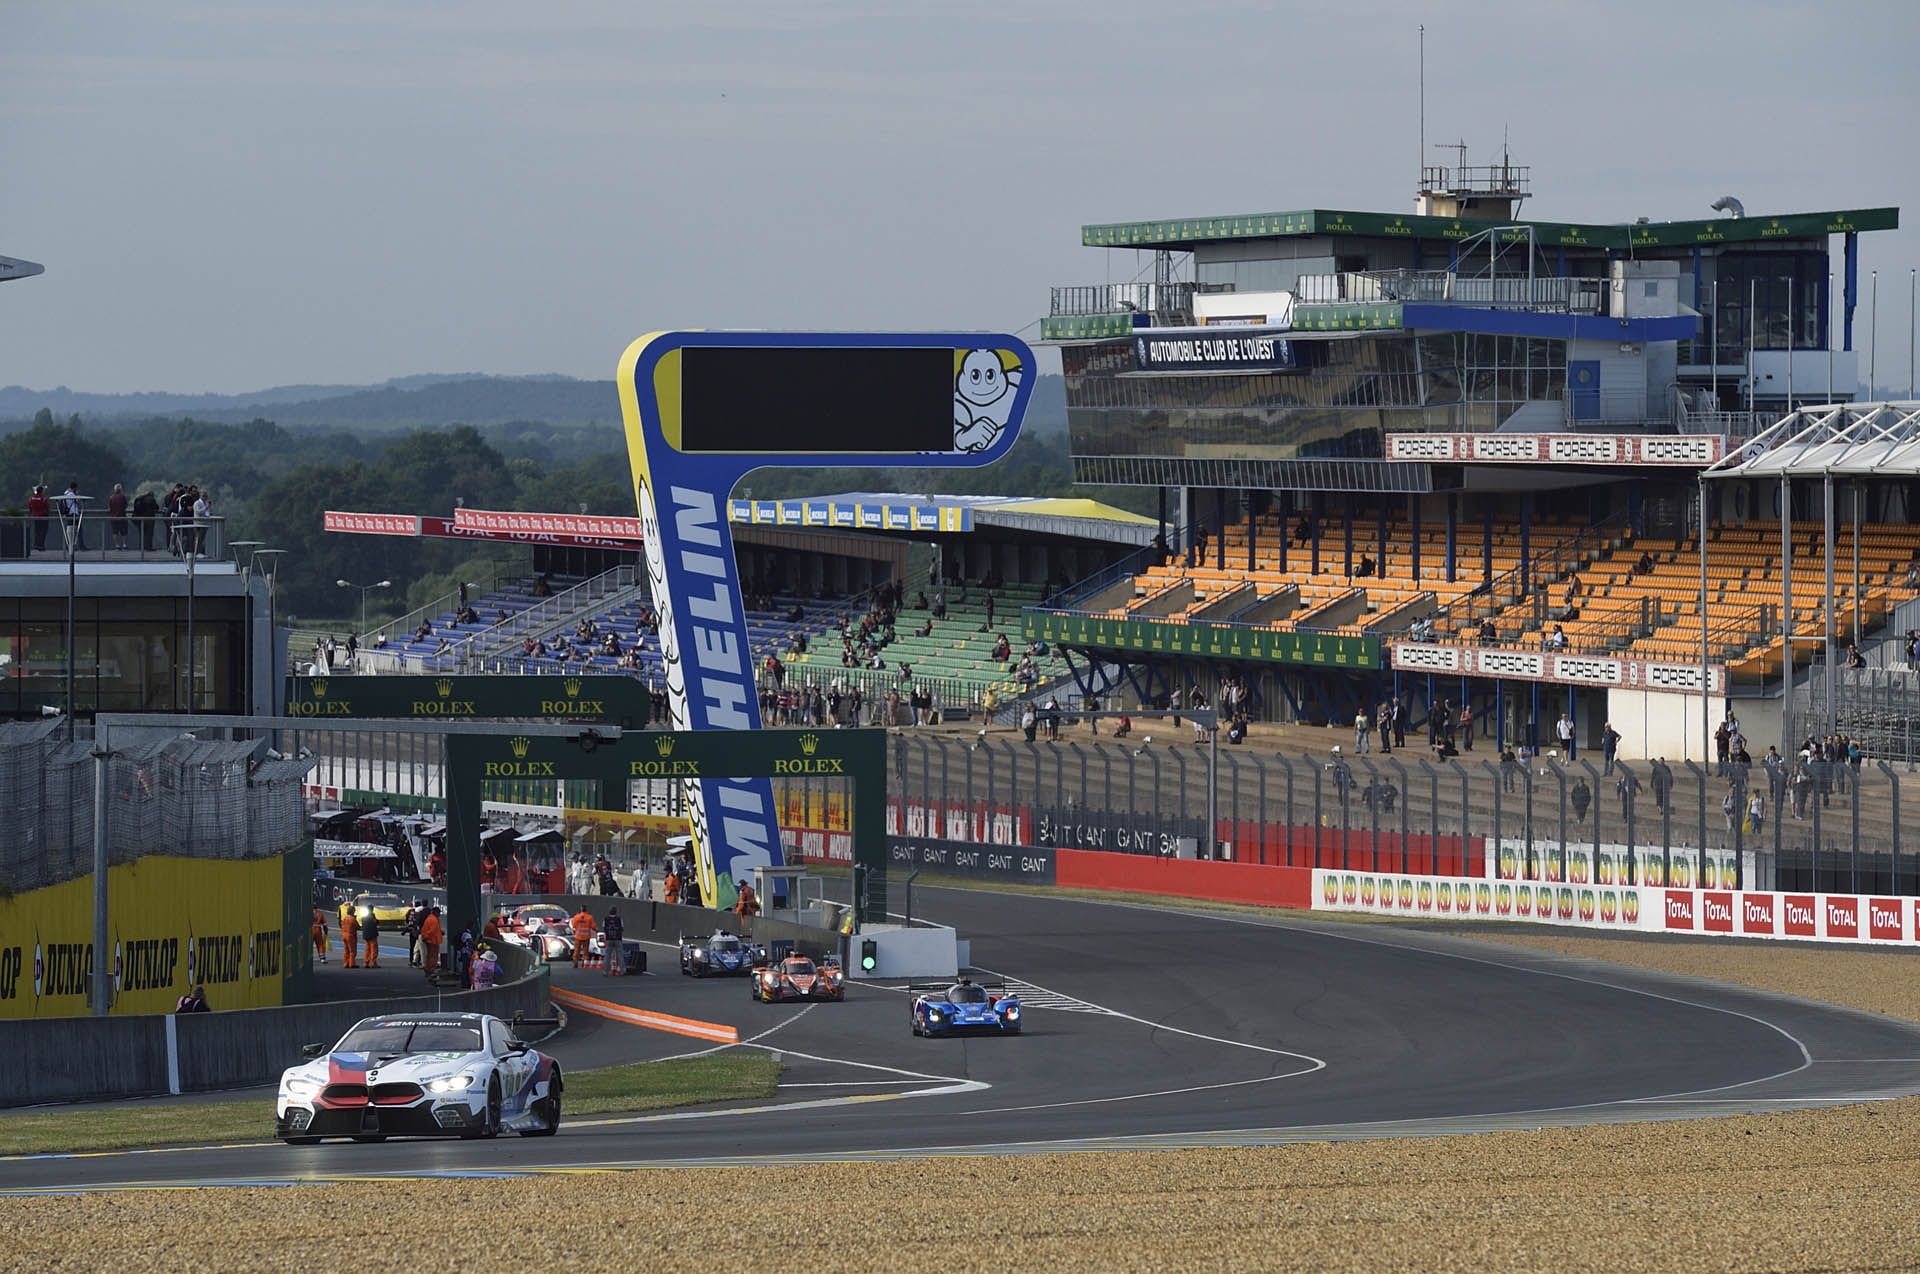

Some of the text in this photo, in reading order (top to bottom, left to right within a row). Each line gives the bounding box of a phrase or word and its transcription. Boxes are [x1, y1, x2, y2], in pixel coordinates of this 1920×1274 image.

[1326, 223, 1587, 244] ROLEX ROLEX ROLEX ROLEX ROLEX
[1632, 223, 1855, 245] ROLEX ROLEX ROLEX ROLEX
[1150, 339, 1275, 362] AUTOMOBILE CLUB DE L'OUEST
[1398, 439, 1706, 459] PORSCHE PORSCHE PORSCHE PORSCHE
[1402, 648, 1711, 688] PORSCHE PORSCHE PORSCHE PORSCHE
[670, 486, 775, 891] MIHELIN
[287, 700, 605, 715] ROLEX ROLEX ROLEX
[486, 759, 843, 776] ROLEX ROLEX ROLEX
[893, 846, 1047, 873] GANT GANT GANT GANT GANT
[1666, 898, 1692, 919] TOTAL
[1705, 899, 1731, 921] TOTAL
[1745, 901, 1772, 923] TOTAL
[1786, 903, 1813, 925] TOTAL
[1828, 904, 1856, 926] TOTAL
[1871, 906, 1901, 928] TOTAL
[0, 946, 22, 1000] OP
[45, 943, 94, 997] DUNLO
[124, 937, 178, 992] DUNLOP
[196, 935, 242, 985] DUNLOP
